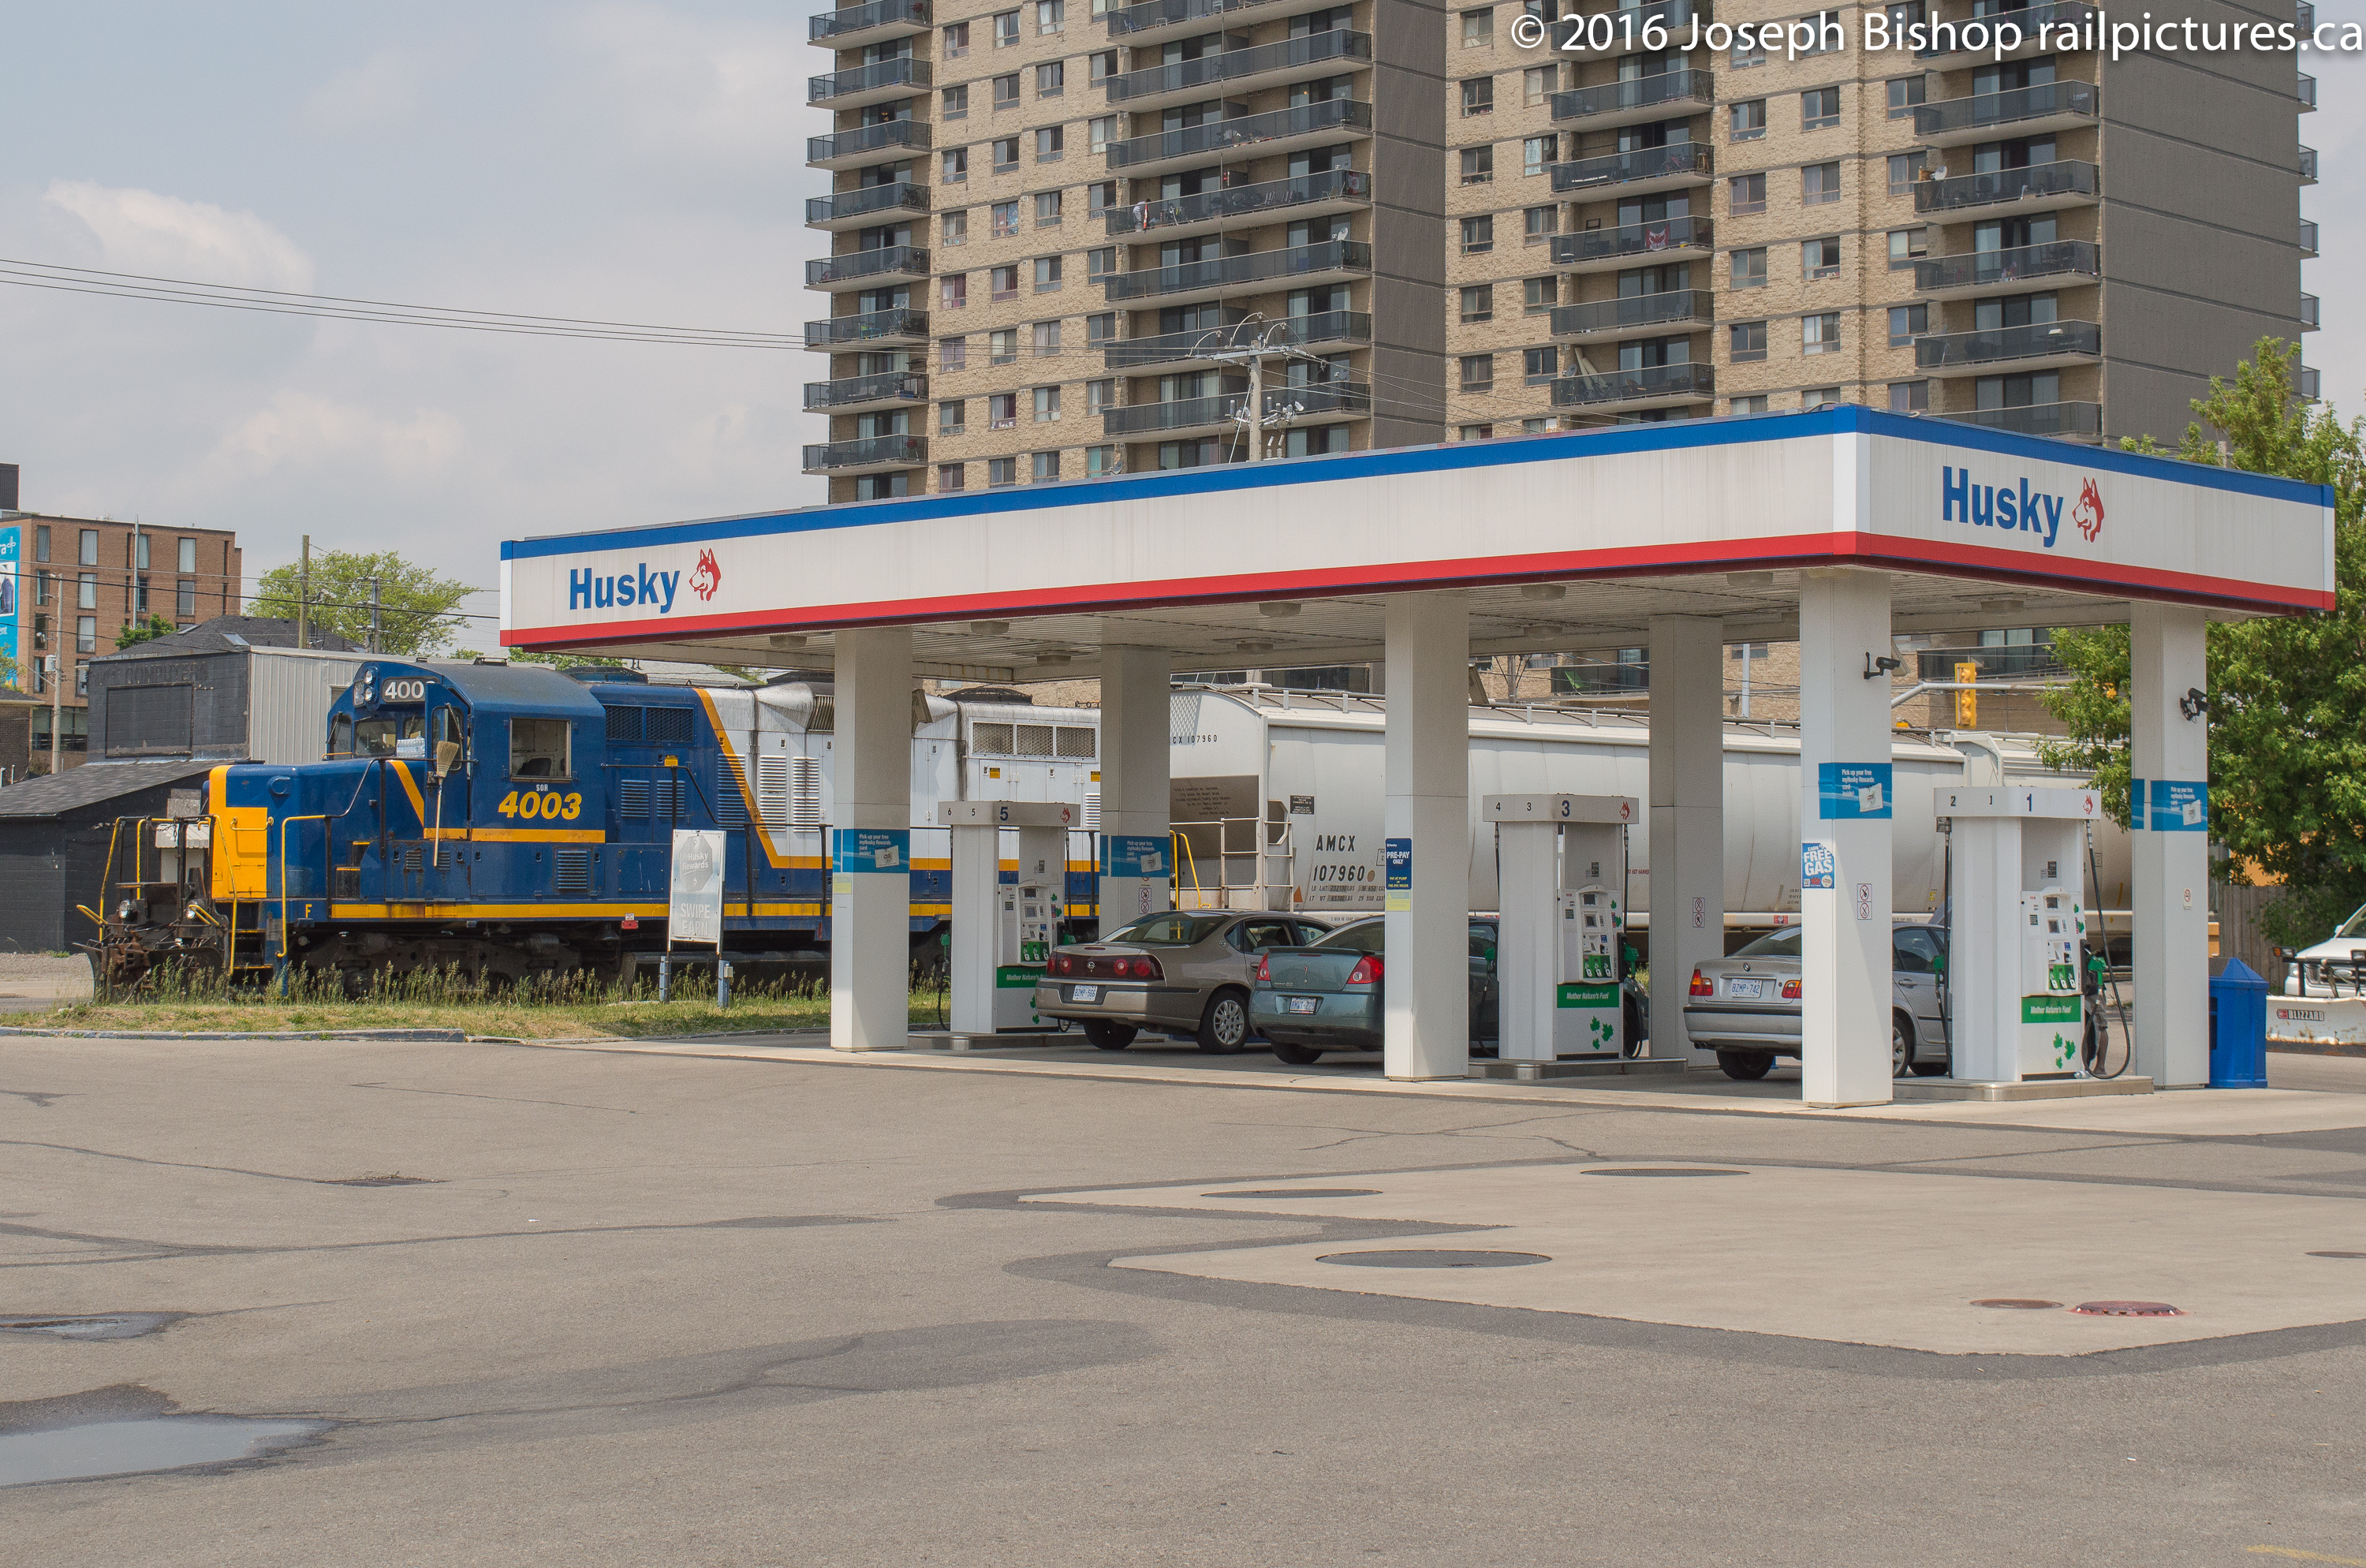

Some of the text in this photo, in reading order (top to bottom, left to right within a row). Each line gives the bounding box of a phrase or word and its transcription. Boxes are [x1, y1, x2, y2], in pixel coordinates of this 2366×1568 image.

[1942, 465, 2064, 548] Husky
[569, 562, 681, 614] Husky
[384, 680, 435, 700] 400
[1187, 734, 1218, 744] 107960
[498, 791, 583, 820] 4003
[1495, 802, 1501, 811] 4
[1526, 802, 1532, 811] 3
[1950, 795, 1957, 807] 2
[1989, 795, 1993, 805] 1
[2026, 793, 2032, 812] 1
[999, 806, 1009, 821] 5
[1561, 800, 1570, 817] 3
[1315, 834, 1356, 852] AMCX
[1803, 849, 1831, 863] FREE
[682, 861, 709, 871] Rewards
[1313, 864, 1365, 882] 107960
[1804, 859, 1833, 876] GAS
[305, 904, 312, 918] F
[680, 902, 711, 919] SWIPE
[681, 920, 709, 937] EARN
[2046, 1006, 2062, 1014] Nature's
[2062, 1006, 2071, 1014] Fuel
[2288, 1010, 2324, 1021] BLIZZARD
